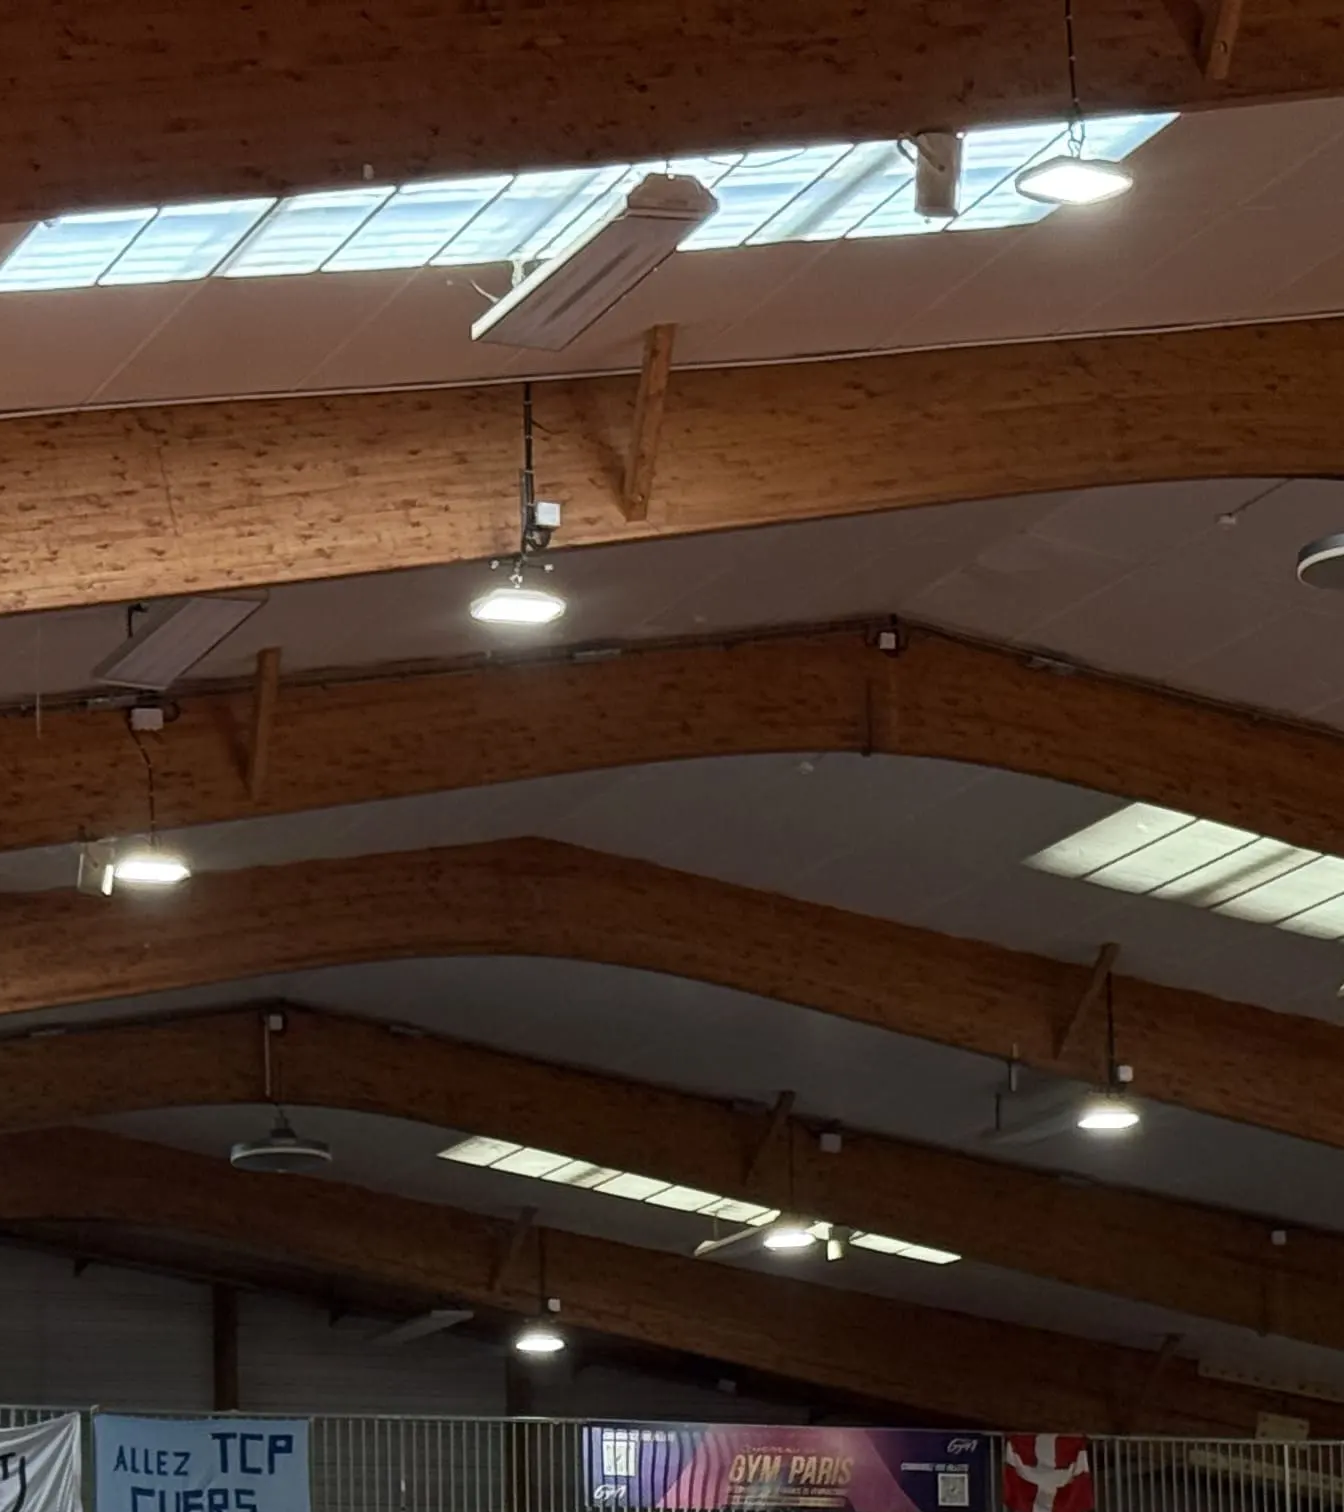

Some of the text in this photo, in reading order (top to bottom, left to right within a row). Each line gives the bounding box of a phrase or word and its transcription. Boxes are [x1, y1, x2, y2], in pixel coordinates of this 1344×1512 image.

[113, 1432, 294, 1477] ALLEZ TCP
[729, 1453, 854, 1485] GYM PARIS
